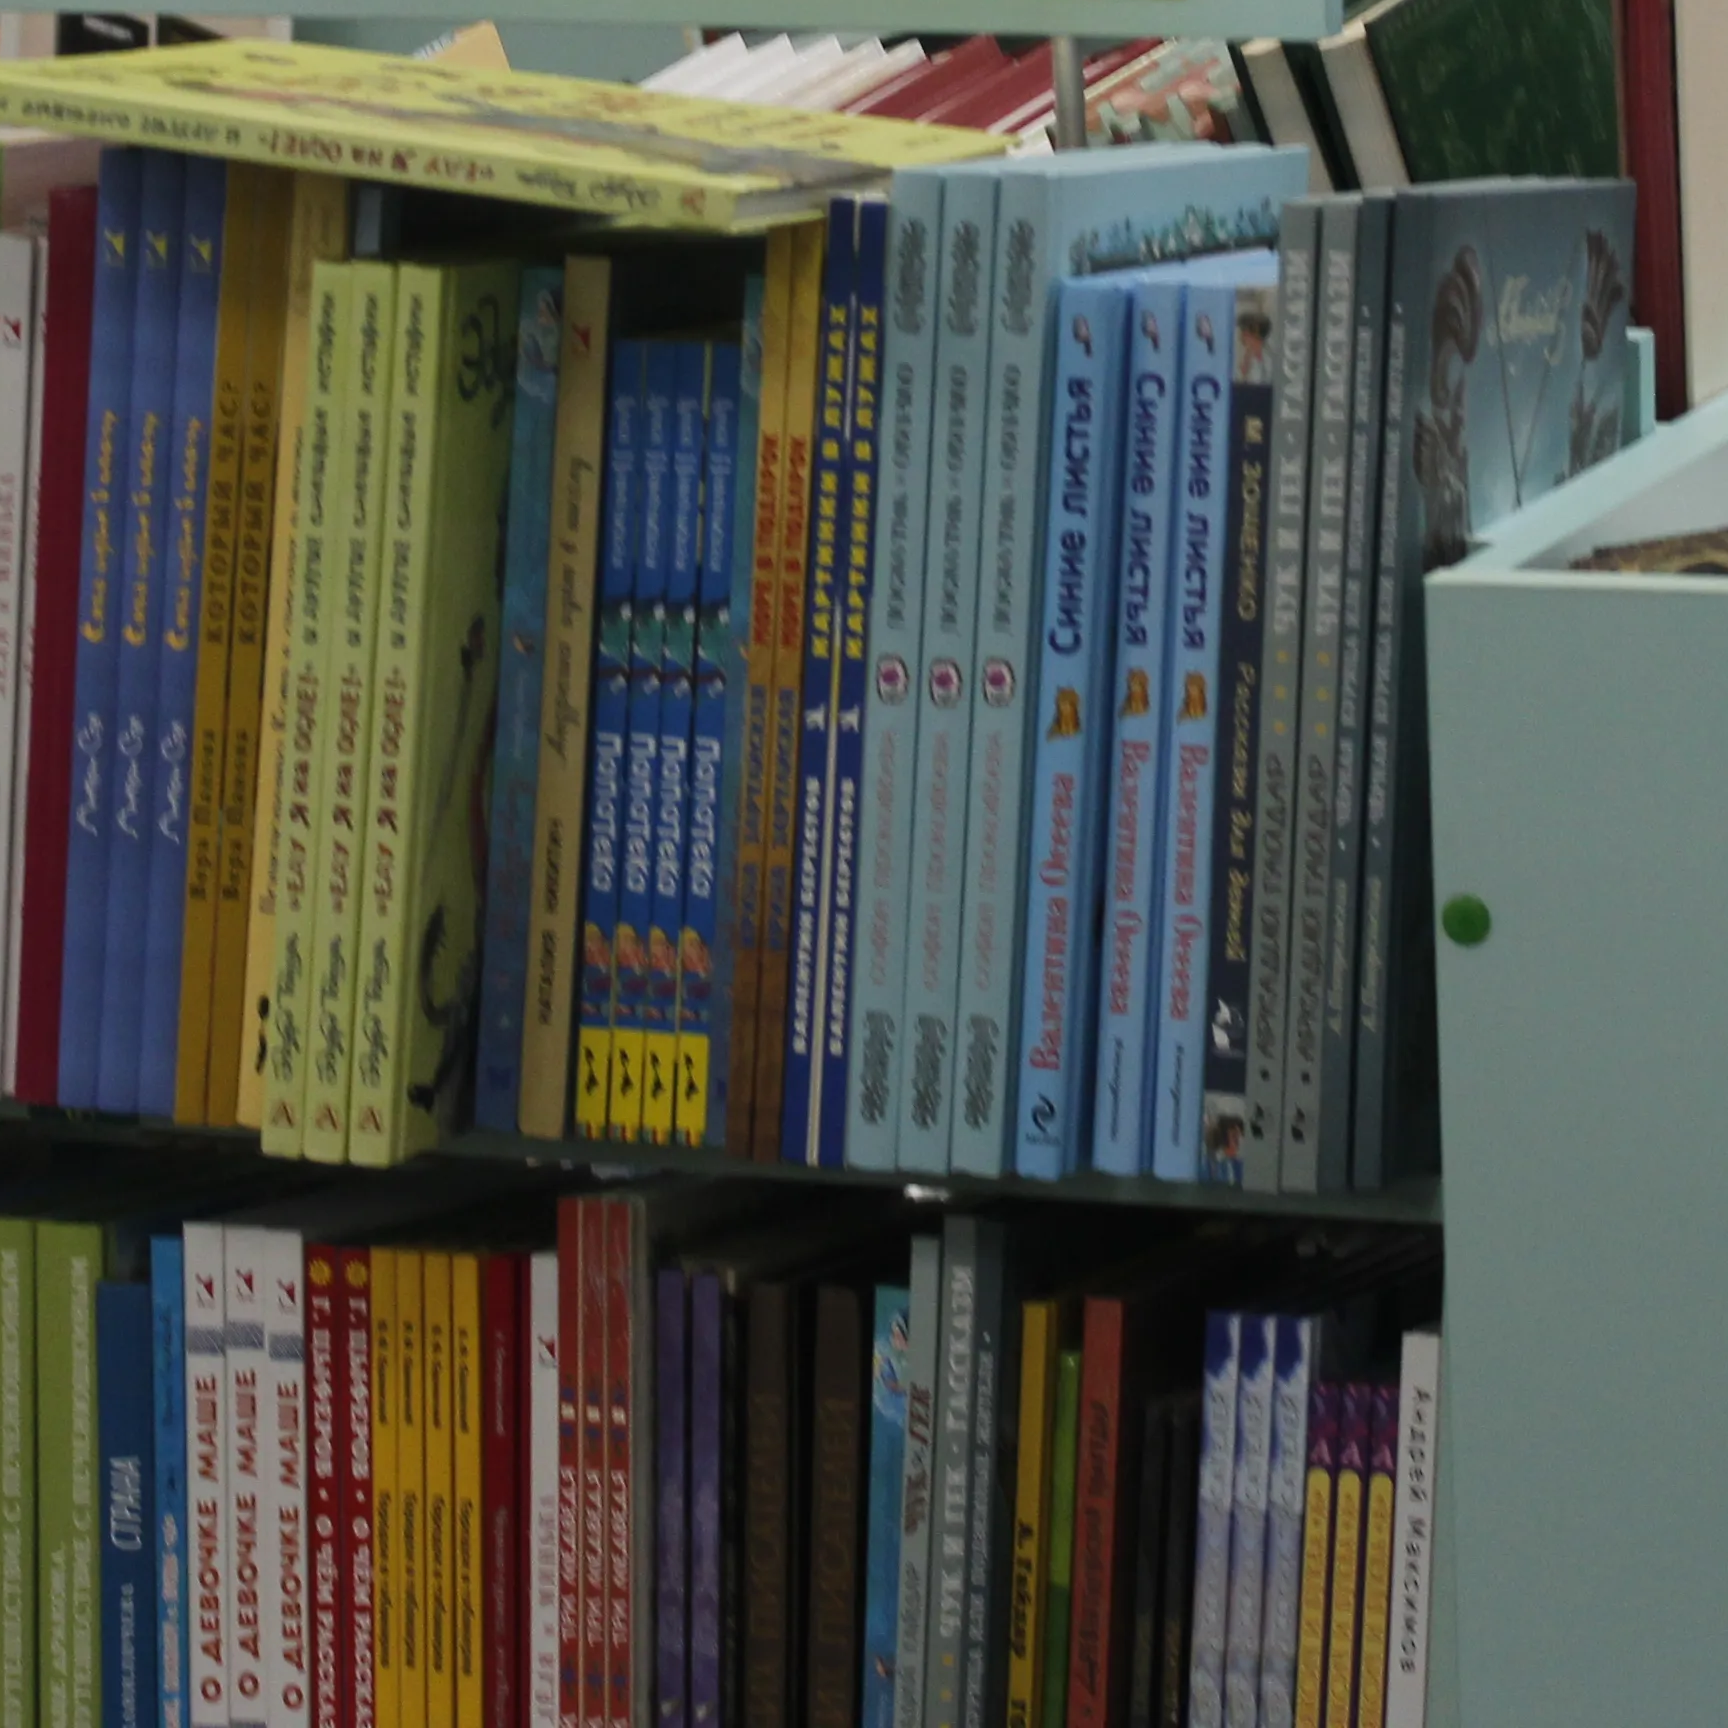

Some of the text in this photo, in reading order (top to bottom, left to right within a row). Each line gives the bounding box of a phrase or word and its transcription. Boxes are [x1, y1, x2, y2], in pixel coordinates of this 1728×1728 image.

[206, 480, 234, 644] КОТОРЫЙ
[236, 480, 265, 646] КОТОРЫЙ
[752, 432, 779, 645] МОРЕ В ПОДАРОК
[780, 434, 807, 651] МОРЕ В ПОДАРОК
[810, 299, 848, 658] КАРТИНКИ В ЛУЖАХ
[845, 302, 880, 661] КАРТИНКИ В ЛУЖАХ
[1046, 376, 1094, 657] Синие листья
[1120, 373, 1168, 649] Синие листья
[1177, 371, 1218, 652] Синие листья
[1235, 457, 1263, 620] ЗОЩЕНКО
[1271, 568, 1301, 633] ЧУК
[1273, 531, 1304, 557] И
[1274, 457, 1305, 523] ГЕК
[1311, 568, 1342, 635] ЧУК
[1316, 532, 1347, 558] И
[1317, 457, 1349, 522] ГЕК
[790, 773, 823, 1055] ВАЛЕНТИН БЕРЕСТОВ
[827, 775, 859, 1058] ВАЛЕНТИН БЕРЕСТОВ
[1029, 772, 1075, 1071] Валентина Осеева
[1108, 739, 1150, 1016] Валентина Осеева
[109, 1456, 143, 1550] СТРАНА
[195, 1373, 223, 1703] О ДЕВОЧКЕ МАШЕ
[234, 1368, 261, 1699] О ДЕВОЧКЕ МАШЕ
[277, 1380, 305, 1710] О ДЕВОЧКЕ МАШЕ
[1400, 1385, 1431, 1675] Андрей Максимов
